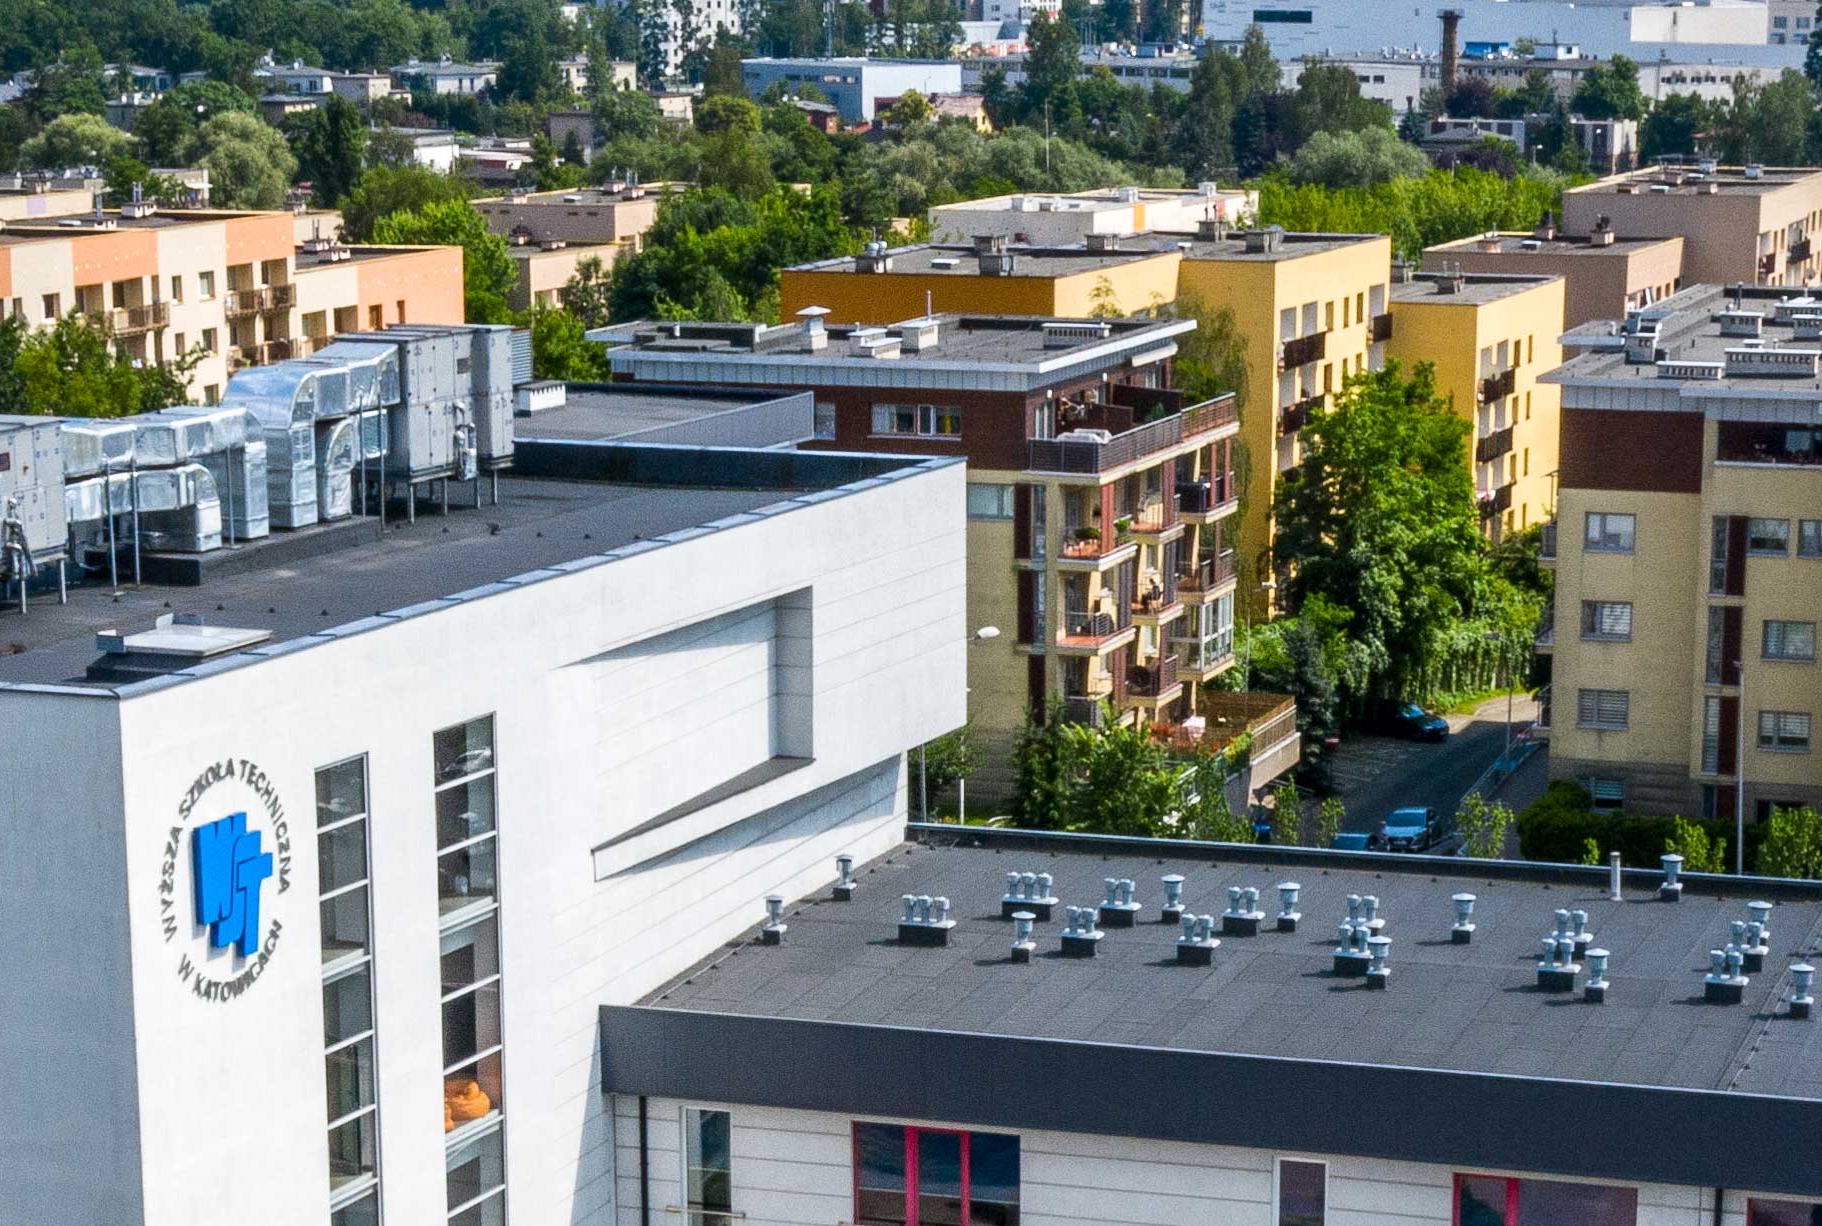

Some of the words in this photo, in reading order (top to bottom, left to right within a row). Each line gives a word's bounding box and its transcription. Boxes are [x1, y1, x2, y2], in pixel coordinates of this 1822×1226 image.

[158, 826, 183, 943] WYŻSZA
[178, 757, 235, 819] SZKOŁA
[238, 758, 291, 895] TECHNICZNA
[178, 953, 194, 982] W
[192, 918, 282, 1003] KATOWICACH
